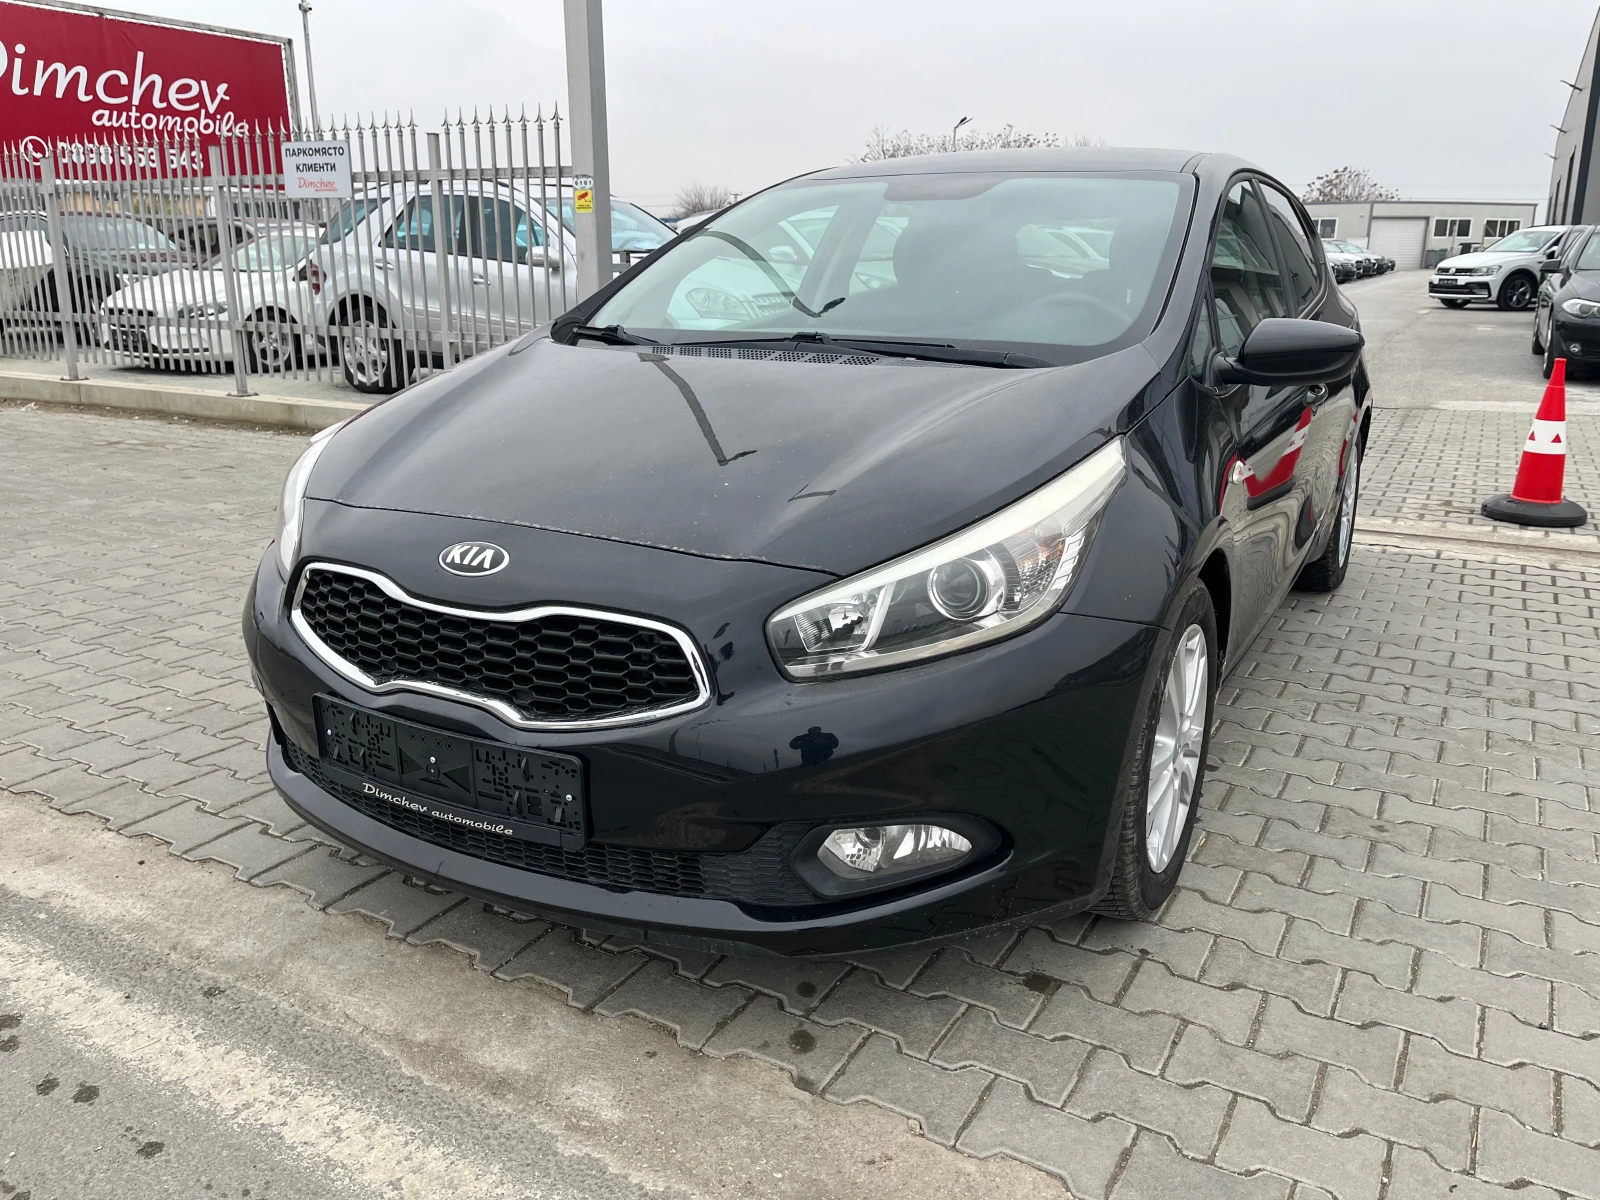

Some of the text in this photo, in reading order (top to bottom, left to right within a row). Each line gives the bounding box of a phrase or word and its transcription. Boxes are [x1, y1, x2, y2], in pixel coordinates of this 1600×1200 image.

[91, 106, 249, 137] automobile
[285, 146, 345, 157] ПАРКОМЯСТО
[295, 162, 336, 173] КЛИЕНТИ
[297, 176, 335, 189] Dimchev
[445, 544, 495, 569] KIA
[362, 782, 514, 836] Dimchev automobile
